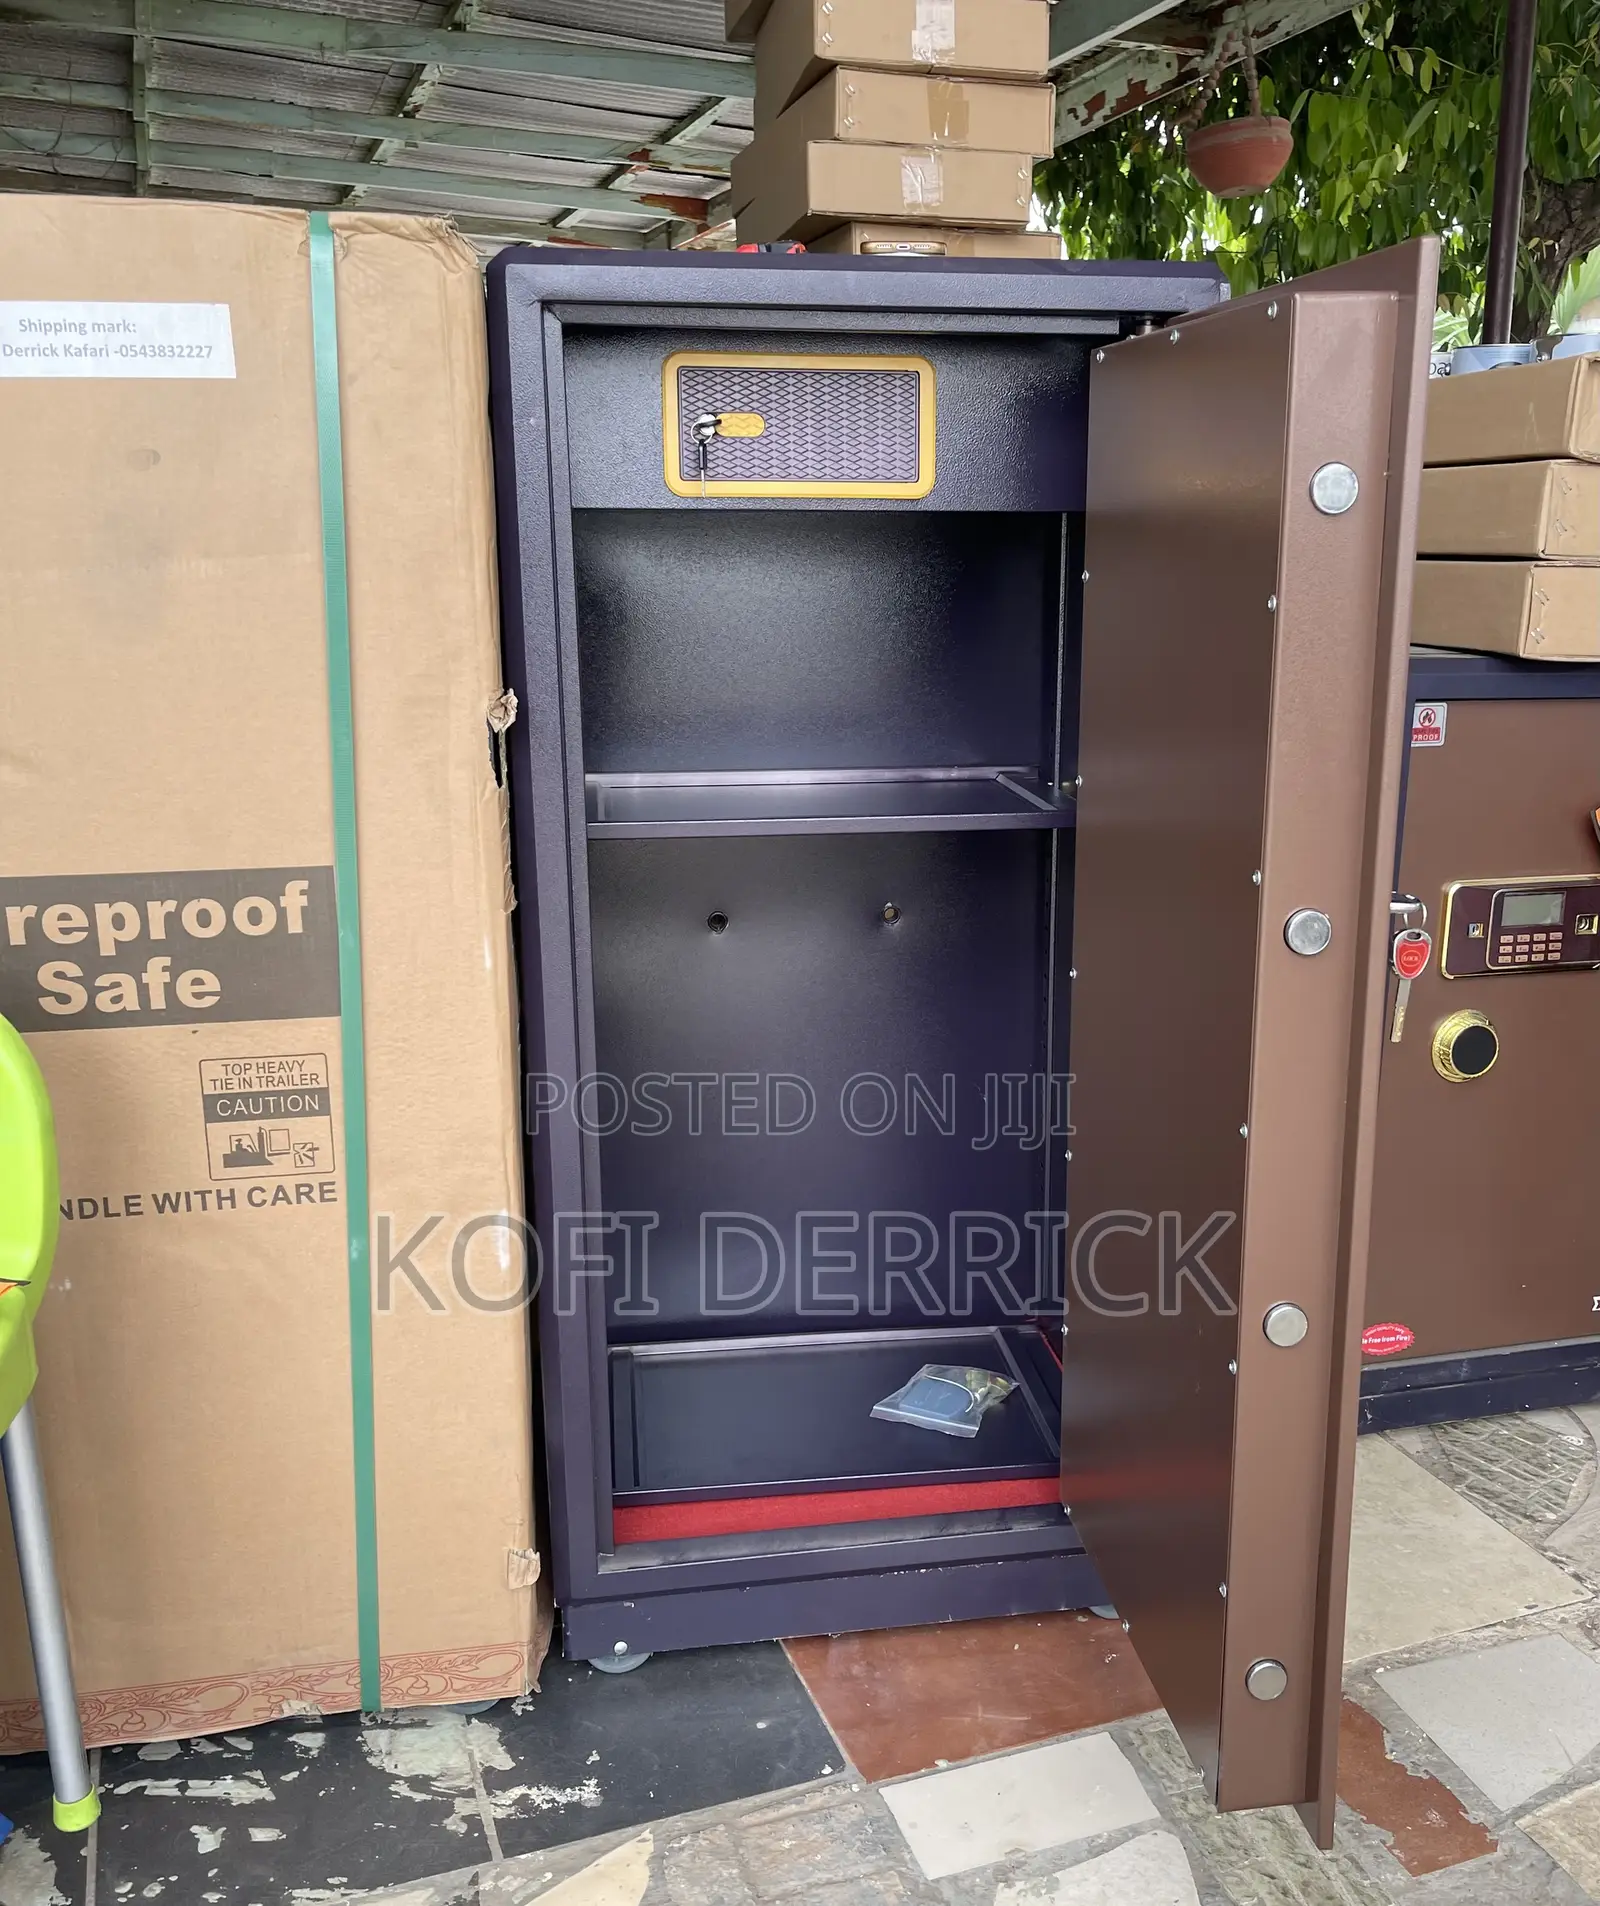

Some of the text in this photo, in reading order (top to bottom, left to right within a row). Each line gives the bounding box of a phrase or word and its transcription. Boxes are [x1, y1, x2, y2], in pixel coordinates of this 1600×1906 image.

[18, 318, 137, 336] Shipping mark:
[2, 343, 60, 358] Derrick
[64, 343, 110, 358] Kafari
[37, 957, 221, 1015] Safe
[221, 1060, 307, 1076] TOP HEAVY
[210, 1073, 320, 1091] TIE IN TRAILER
[217, 1094, 320, 1116] CAUTION
[151, 1188, 236, 1215] WITH
[247, 1181, 338, 1207] CARE
